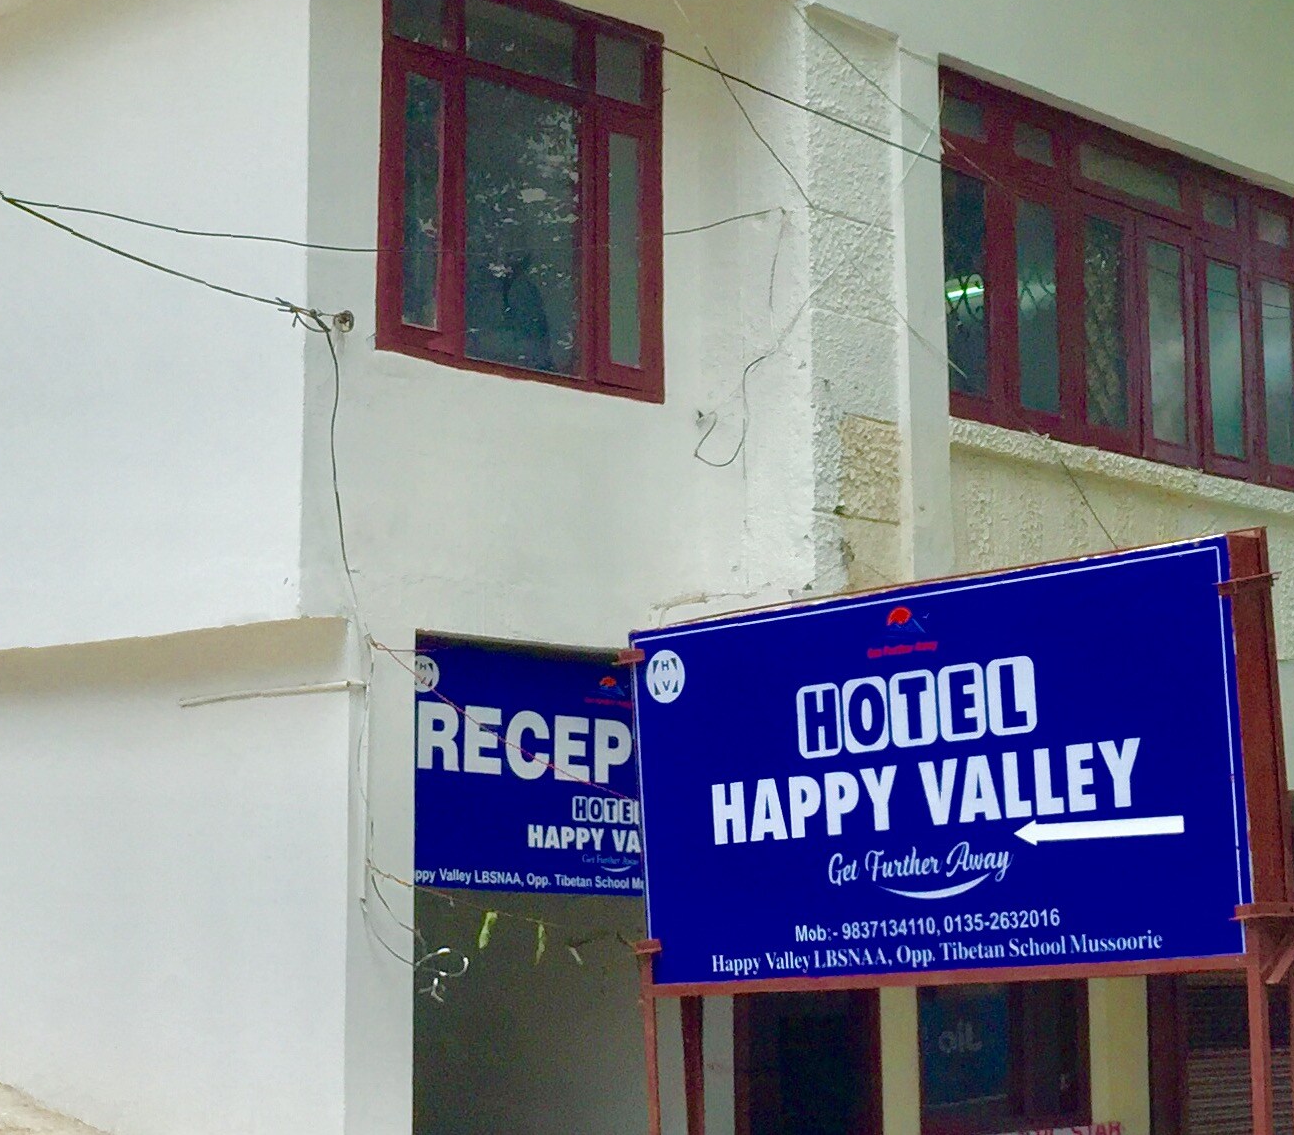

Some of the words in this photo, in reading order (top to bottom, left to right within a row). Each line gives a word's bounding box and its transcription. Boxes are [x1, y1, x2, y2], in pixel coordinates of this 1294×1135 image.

[796, 655, 1038, 759] HOTEL
[416, 700, 633, 784] RECEP
[711, 765, 897, 845] HAPPY
[918, 737, 1141, 825] VALLEY
[527, 824, 605, 851] HAPPY
[439, 867, 472, 885] Valley
[526, 872, 552, 889] Opp.
[554, 873, 593, 887] Tibetan
[594, 875, 630, 890] School
[828, 852, 860, 886] Get
[864, 846, 942, 882] Further
[946, 841, 1014, 882] Away
[943, 908, 1061, 934] 0135-2632016
[712, 954, 761, 976] Happy
[765, 950, 811, 974] Valley
[814, 947, 893, 969] LBSNAA,
[896, 944, 936, 969] Opp.
[939, 941, 1005, 962] Tibetan
[1009, 935, 1067, 958] School
[1069, 929, 1164, 954] Mussoorie
